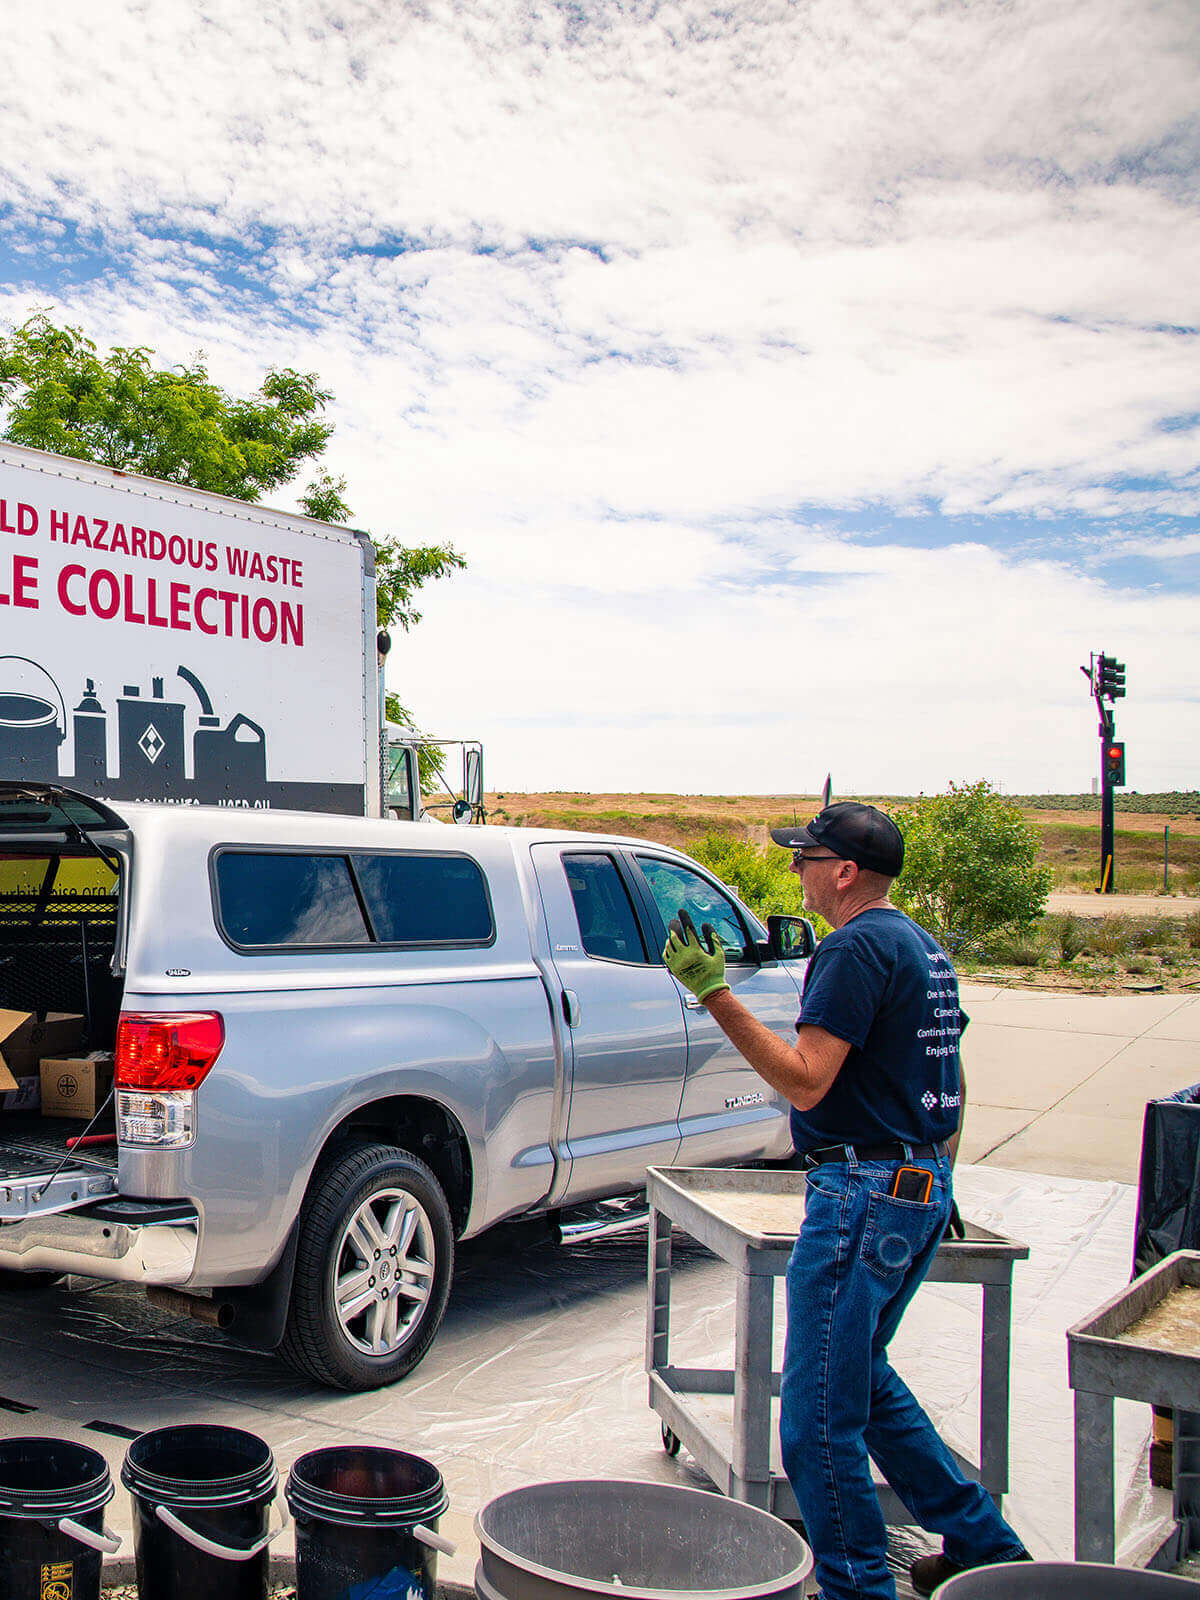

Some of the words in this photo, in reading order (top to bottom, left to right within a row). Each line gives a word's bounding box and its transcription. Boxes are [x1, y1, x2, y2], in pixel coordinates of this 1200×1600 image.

[50, 509, 218, 572] HAZARDOUS
[226, 546, 304, 588] WASTE
[57, 563, 304, 647] COLLECTION
